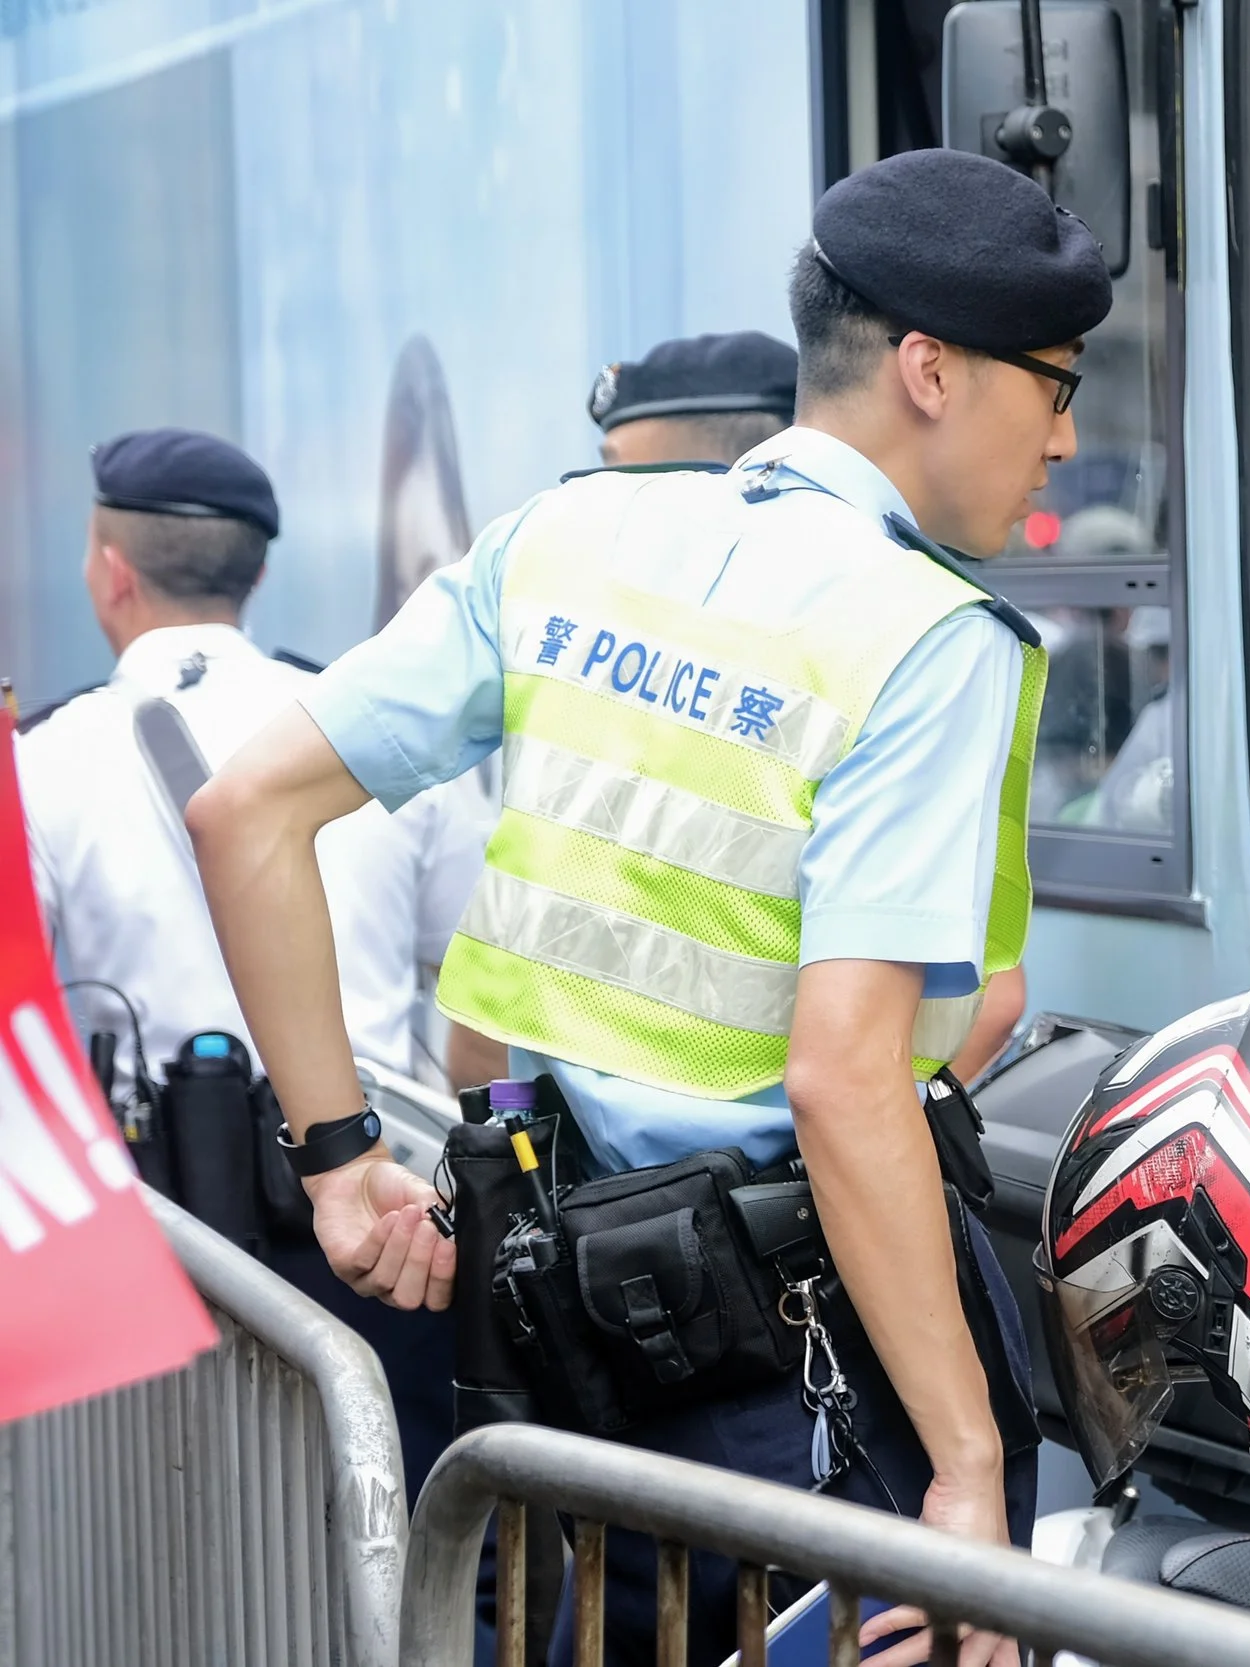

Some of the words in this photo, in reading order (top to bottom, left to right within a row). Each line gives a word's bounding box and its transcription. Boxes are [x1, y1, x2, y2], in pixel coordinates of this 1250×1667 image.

[536, 615, 578, 666] 警
[581, 629, 720, 720] POLICE
[730, 686, 784, 741] 察
